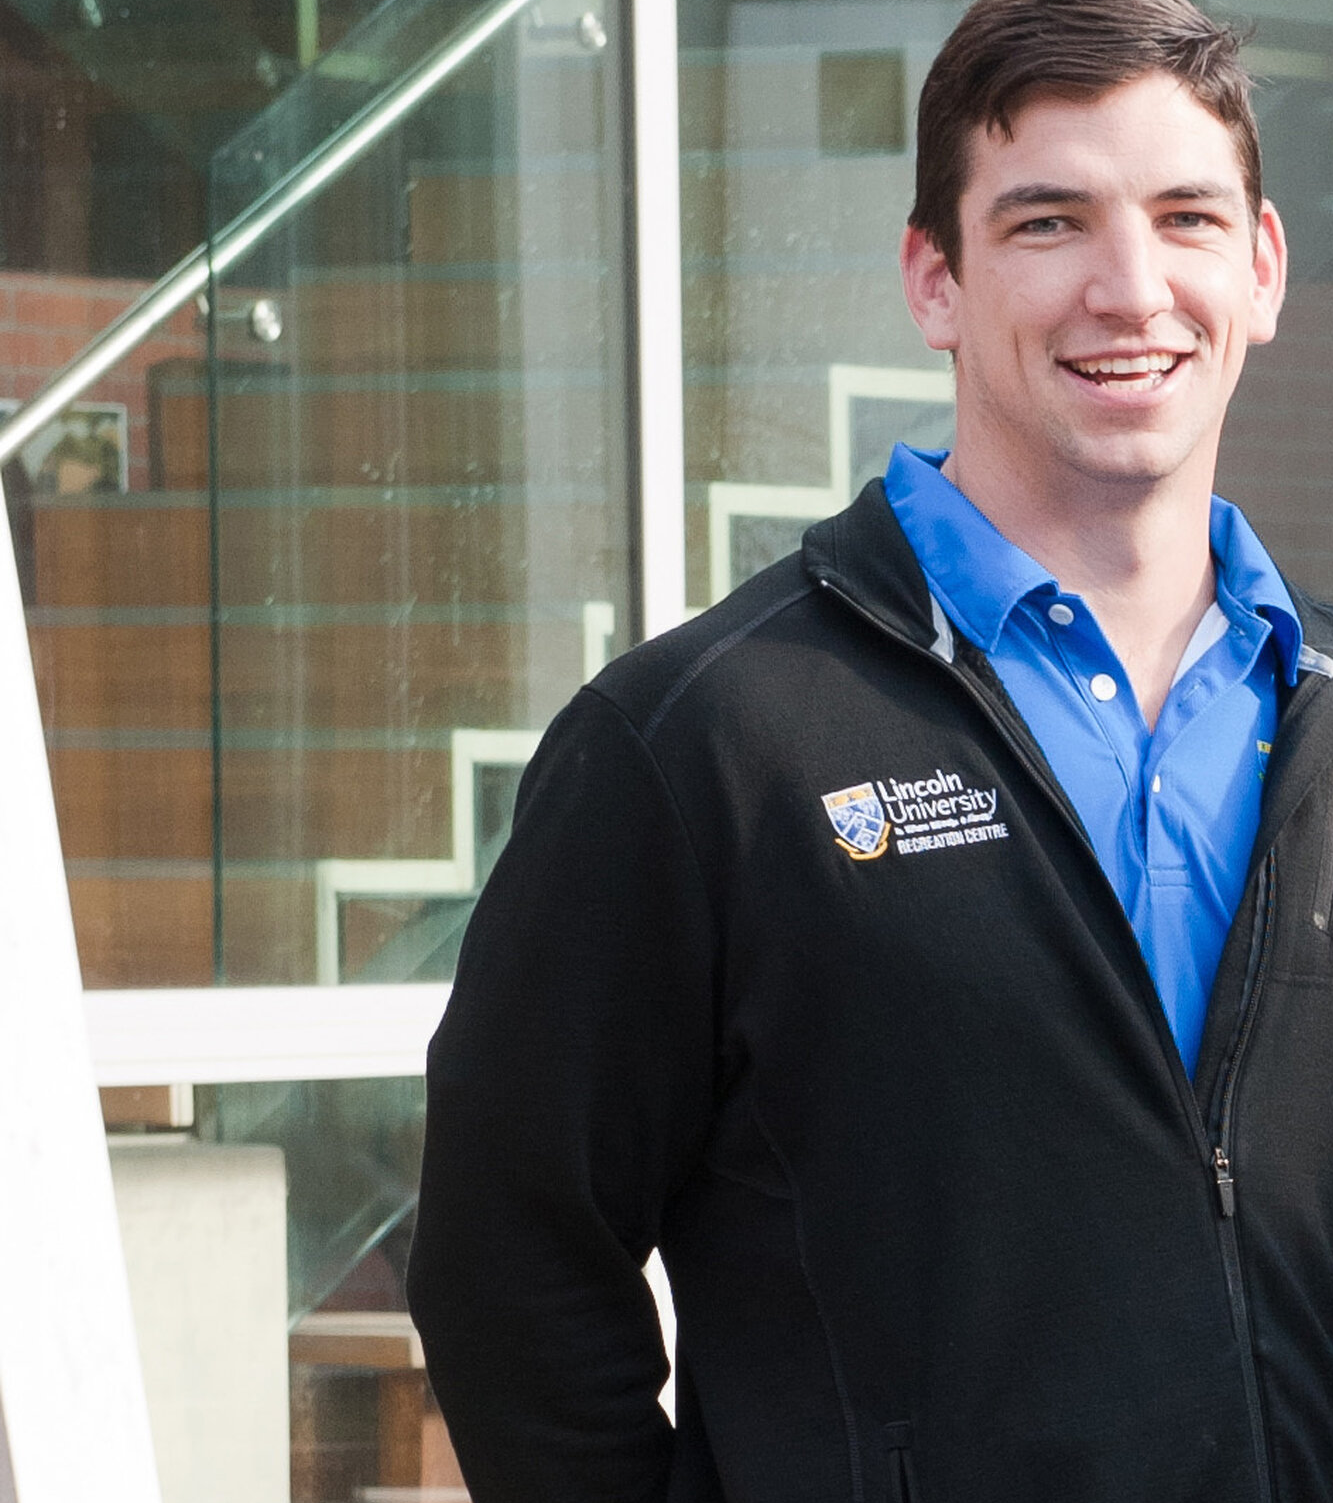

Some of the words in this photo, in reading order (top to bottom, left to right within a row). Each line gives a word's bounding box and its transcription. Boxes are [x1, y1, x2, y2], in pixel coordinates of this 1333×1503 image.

[876, 768, 964, 803] Lincoln
[885, 787, 997, 824] University
[896, 829, 965, 855] RECREATION
[965, 822, 1009, 845] CENTRE
